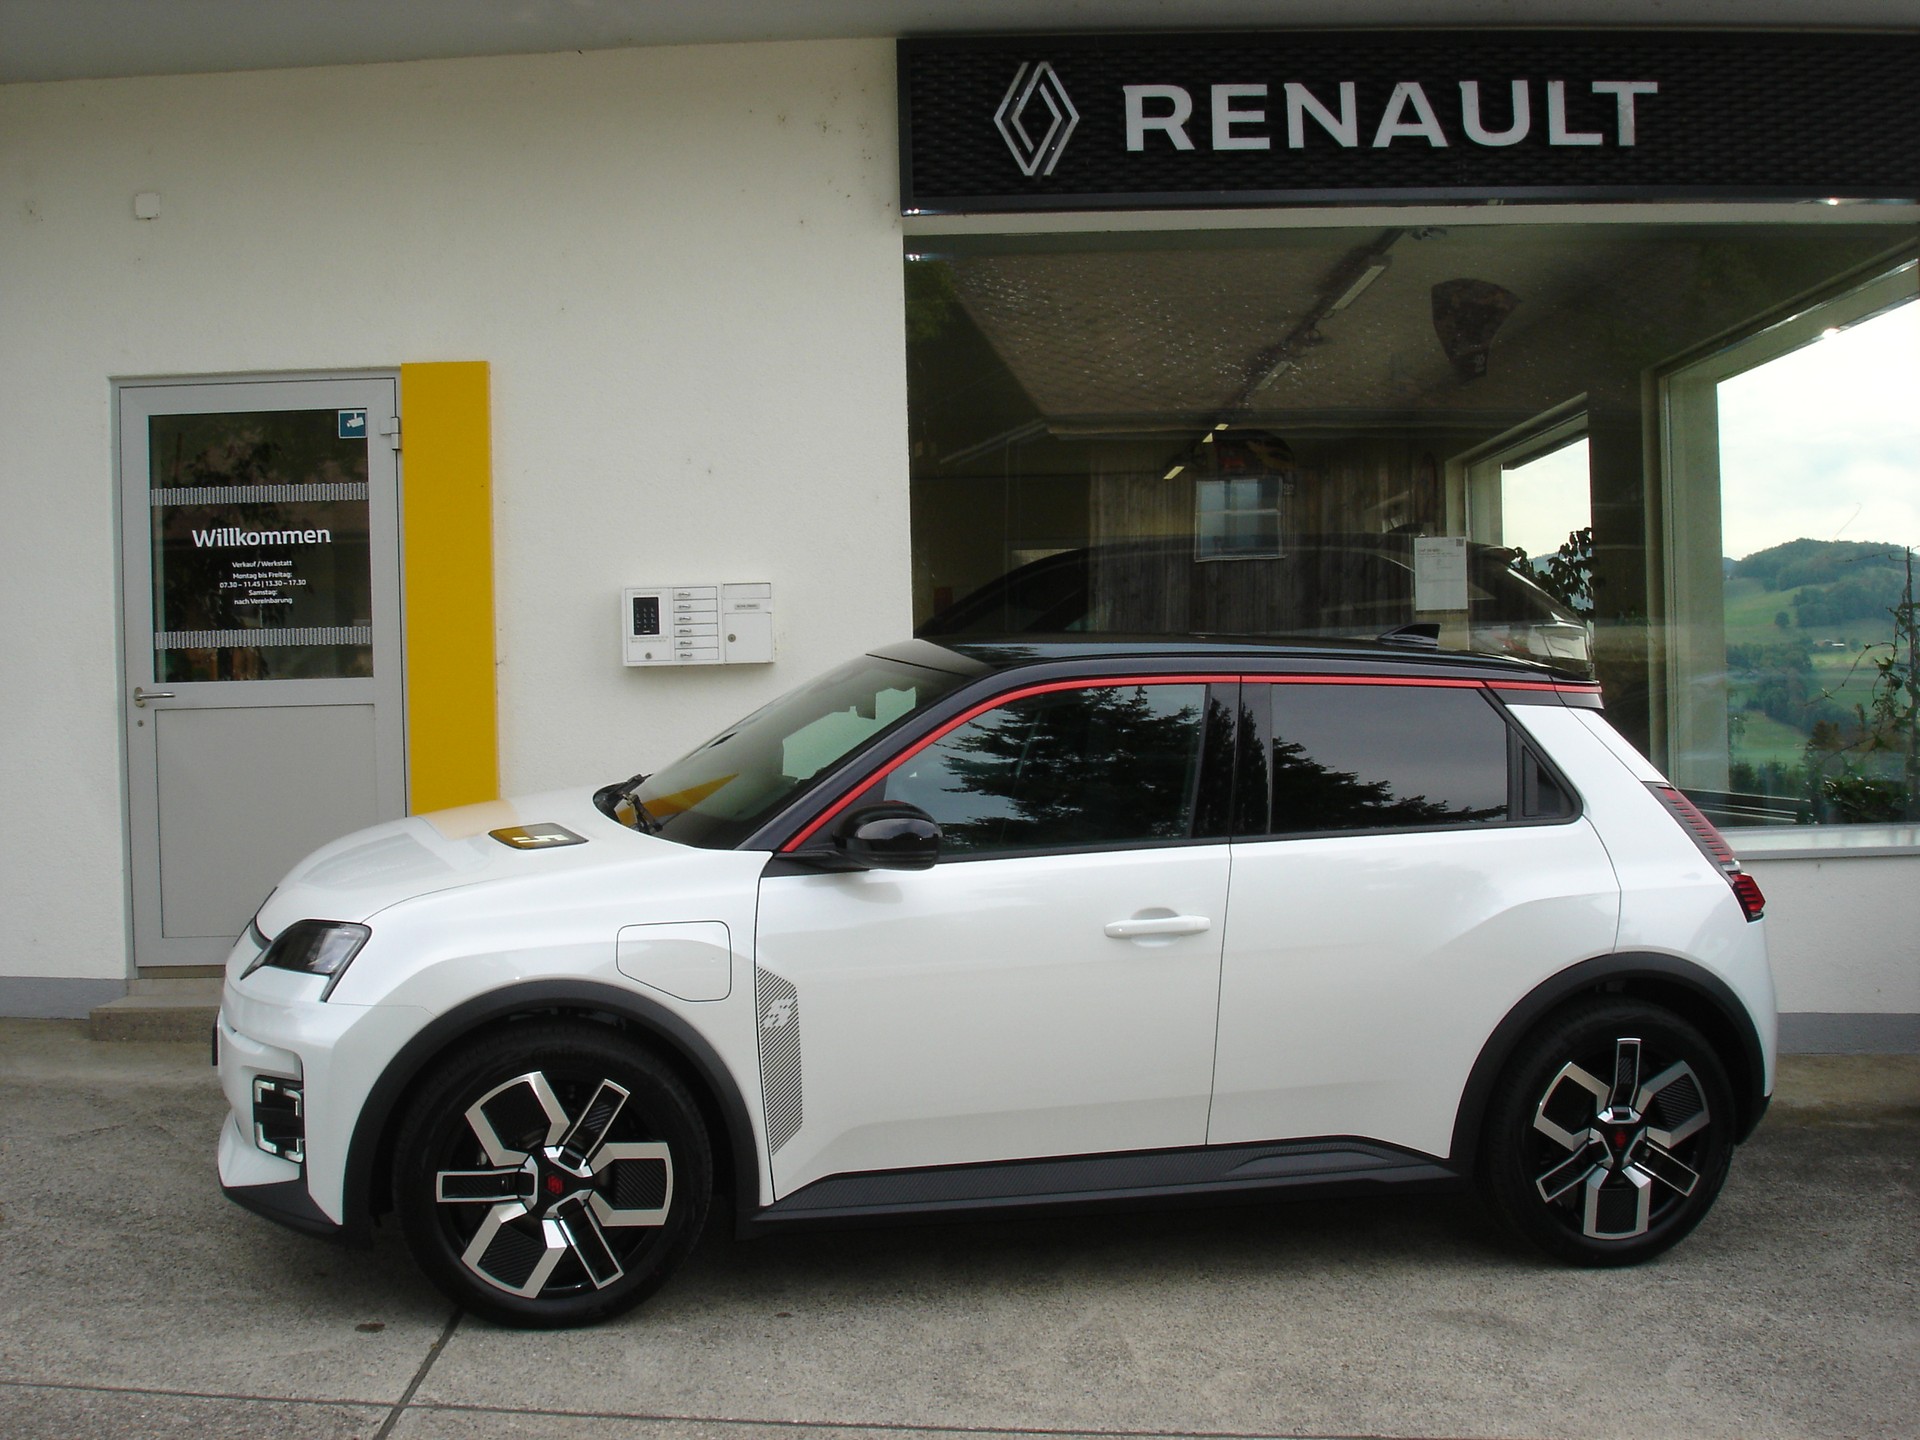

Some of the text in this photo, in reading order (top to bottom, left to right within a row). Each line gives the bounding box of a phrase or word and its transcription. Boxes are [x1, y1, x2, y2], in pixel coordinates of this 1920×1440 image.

[1123, 79, 1659, 151] RENAULT
[192, 527, 331, 548] Willkommen
[268, 571, 292, 579] Freitag:
[250, 597, 293, 605] Vereinbarung
